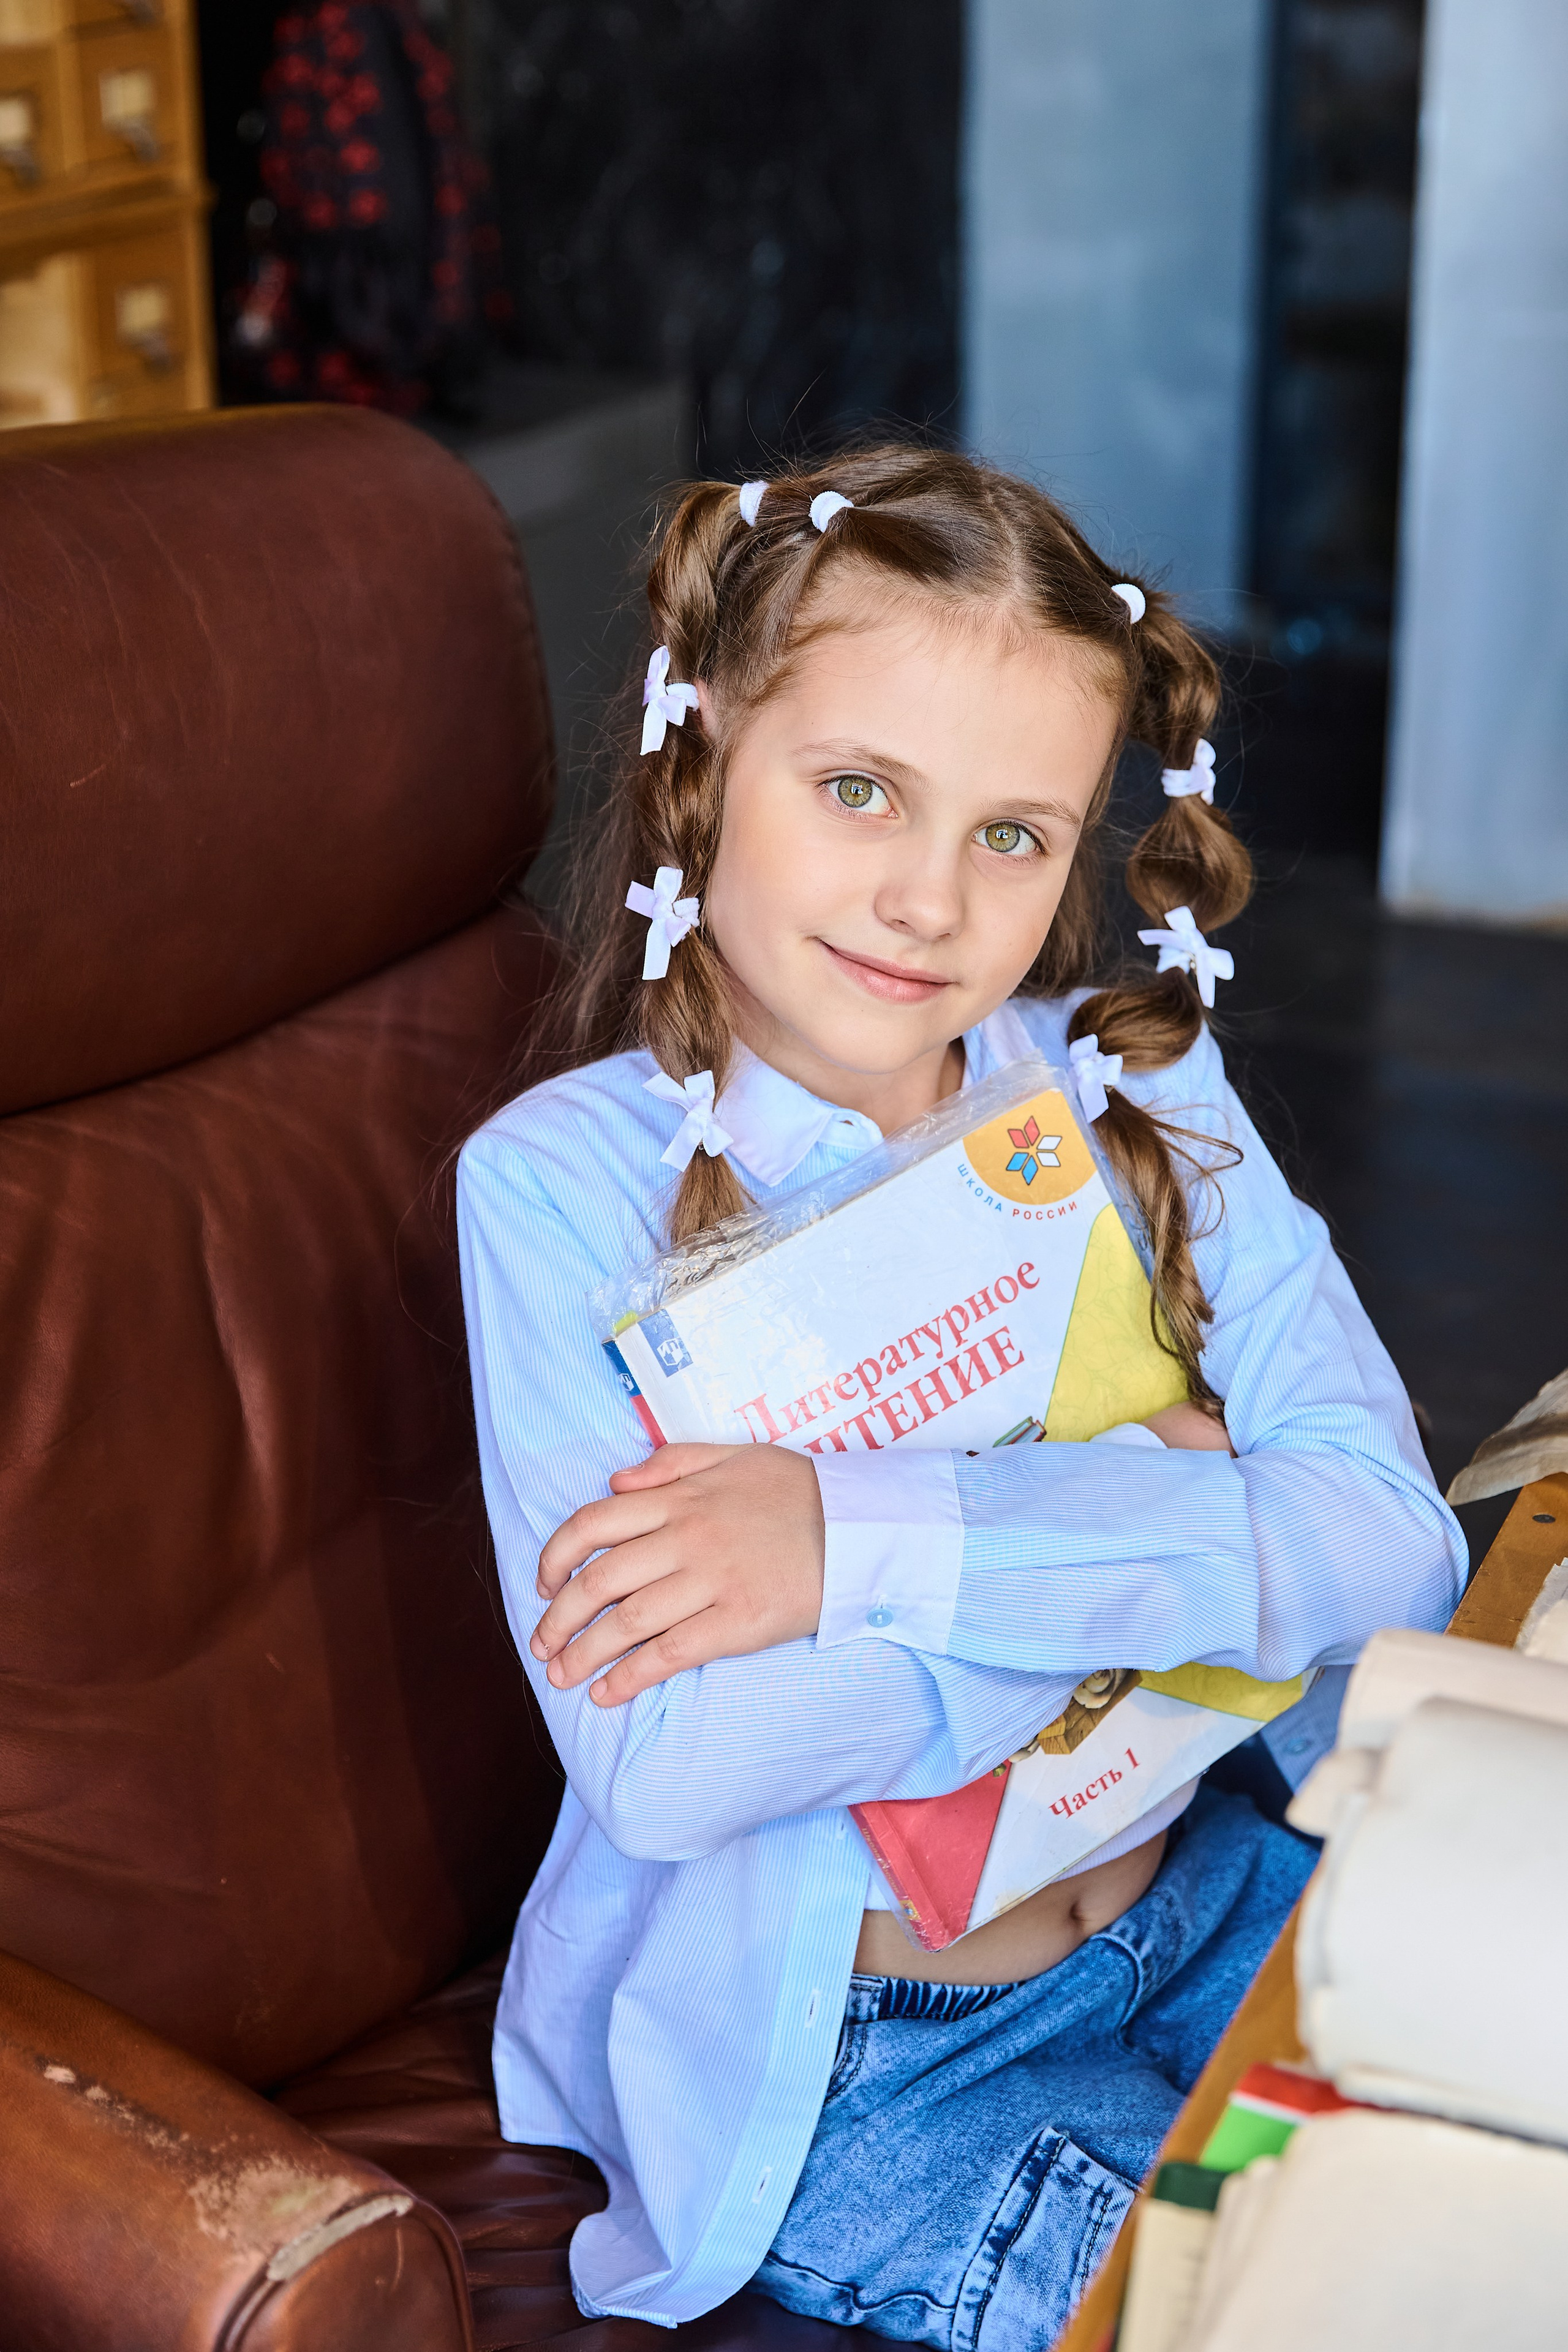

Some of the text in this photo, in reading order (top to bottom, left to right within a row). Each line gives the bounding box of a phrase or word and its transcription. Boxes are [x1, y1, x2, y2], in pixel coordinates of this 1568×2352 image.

[957, 1164, 1077, 1220] ШКОЛА РОССИИ
[734, 1262, 1040, 1443] Литературное
[1048, 1747, 1140, 1819] Часть 1
